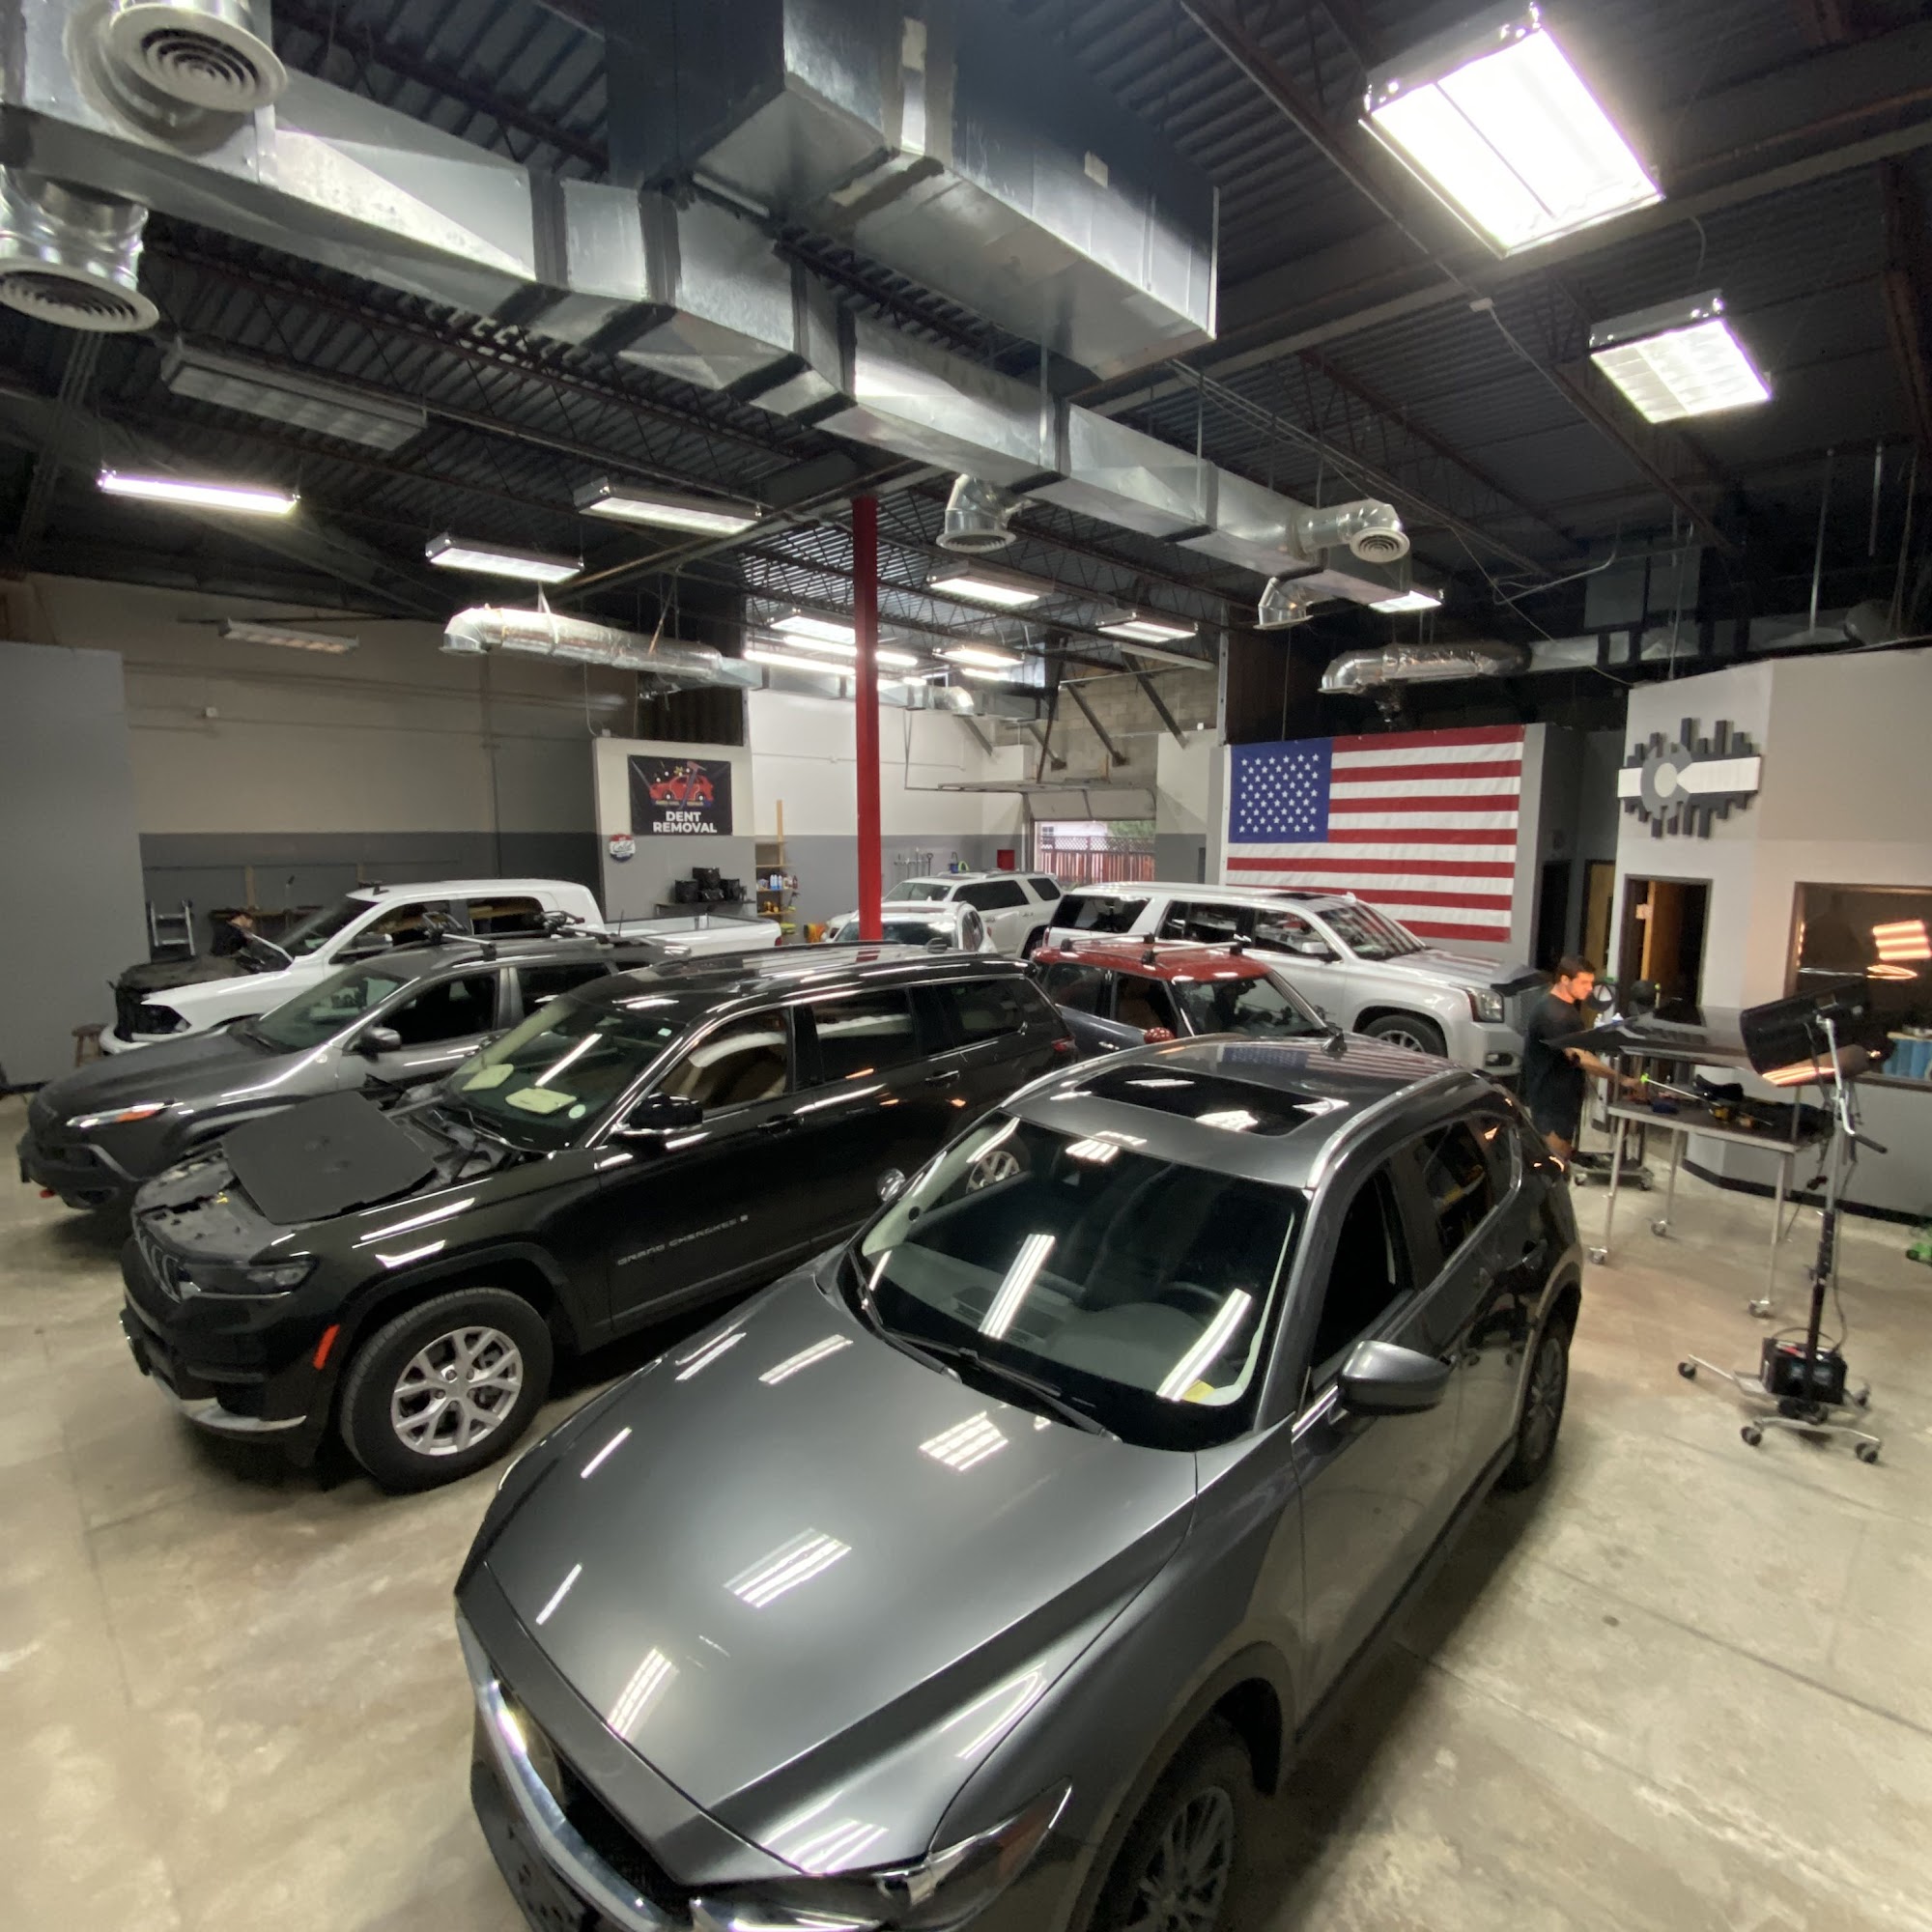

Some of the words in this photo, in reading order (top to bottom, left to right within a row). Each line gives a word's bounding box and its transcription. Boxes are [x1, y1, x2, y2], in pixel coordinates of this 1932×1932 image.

[666, 810, 701, 822] DENT
[653, 821, 718, 833] REMOVAL
[617, 1243, 665, 1265] GRAND
[668, 1219, 737, 1247] CHEROKEE
